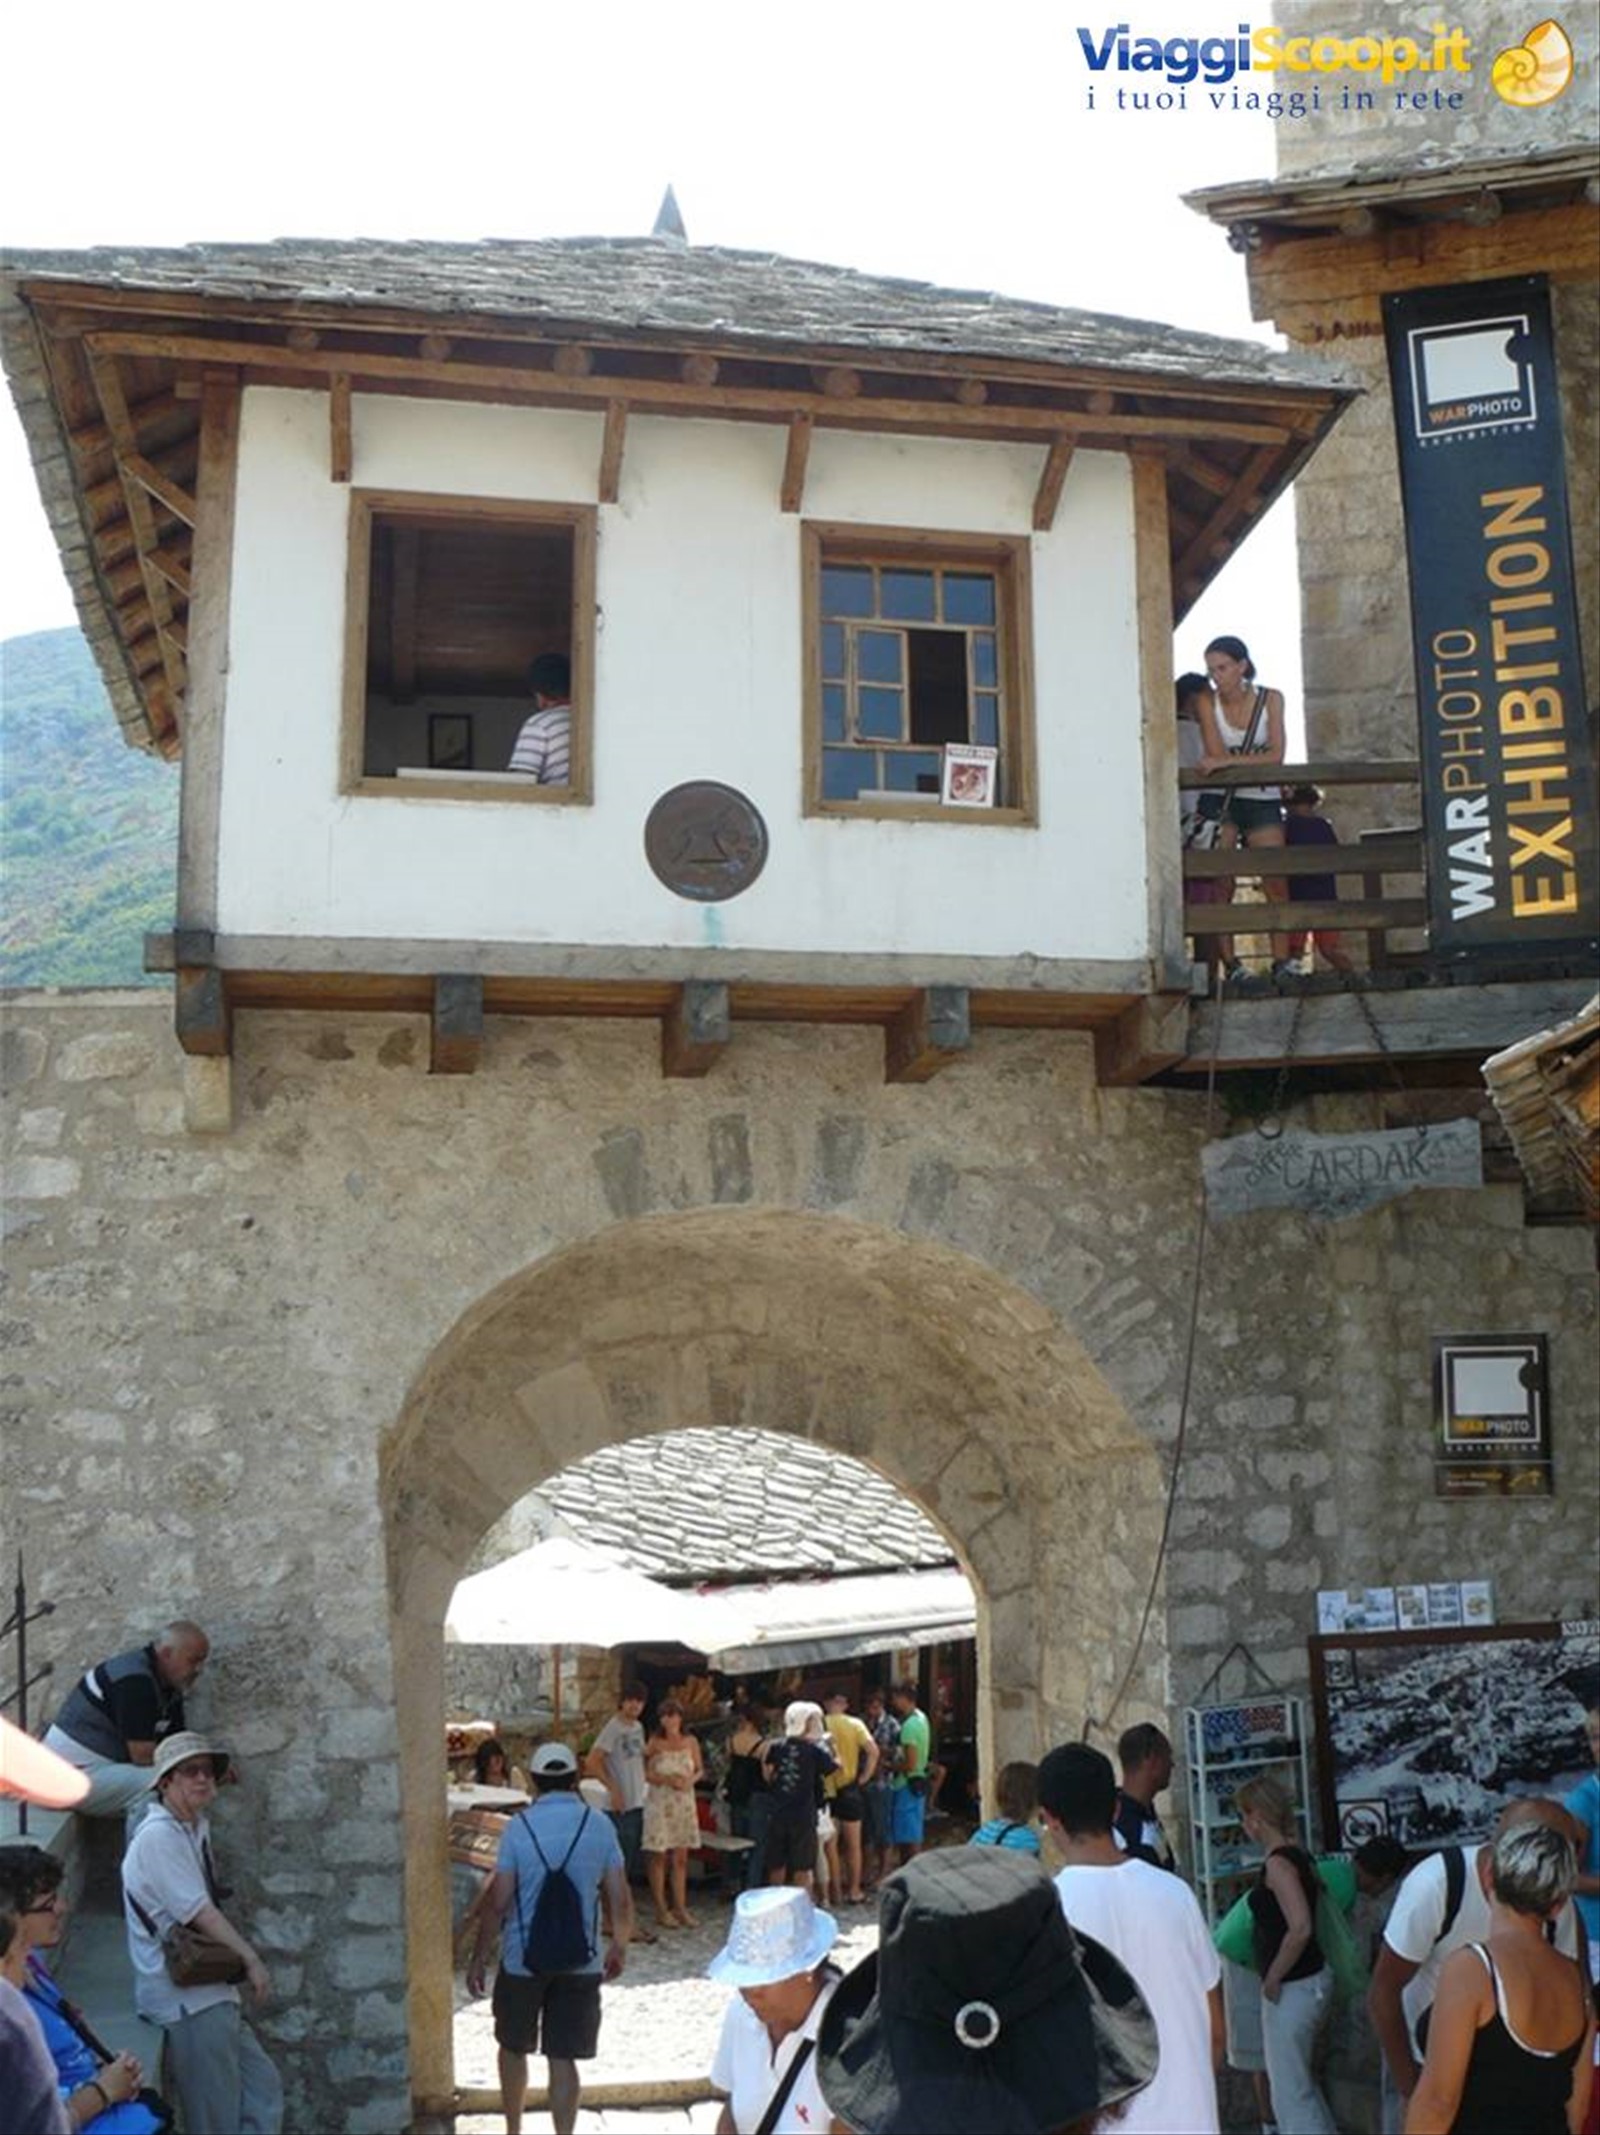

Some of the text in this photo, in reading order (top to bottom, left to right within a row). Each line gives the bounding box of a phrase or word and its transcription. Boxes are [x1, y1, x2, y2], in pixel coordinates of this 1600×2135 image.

[1428, 397, 1522, 425] WARPHOTO
[1433, 629, 1496, 920] WARPHOTO
[1481, 486, 1578, 917] EXHIBITION
